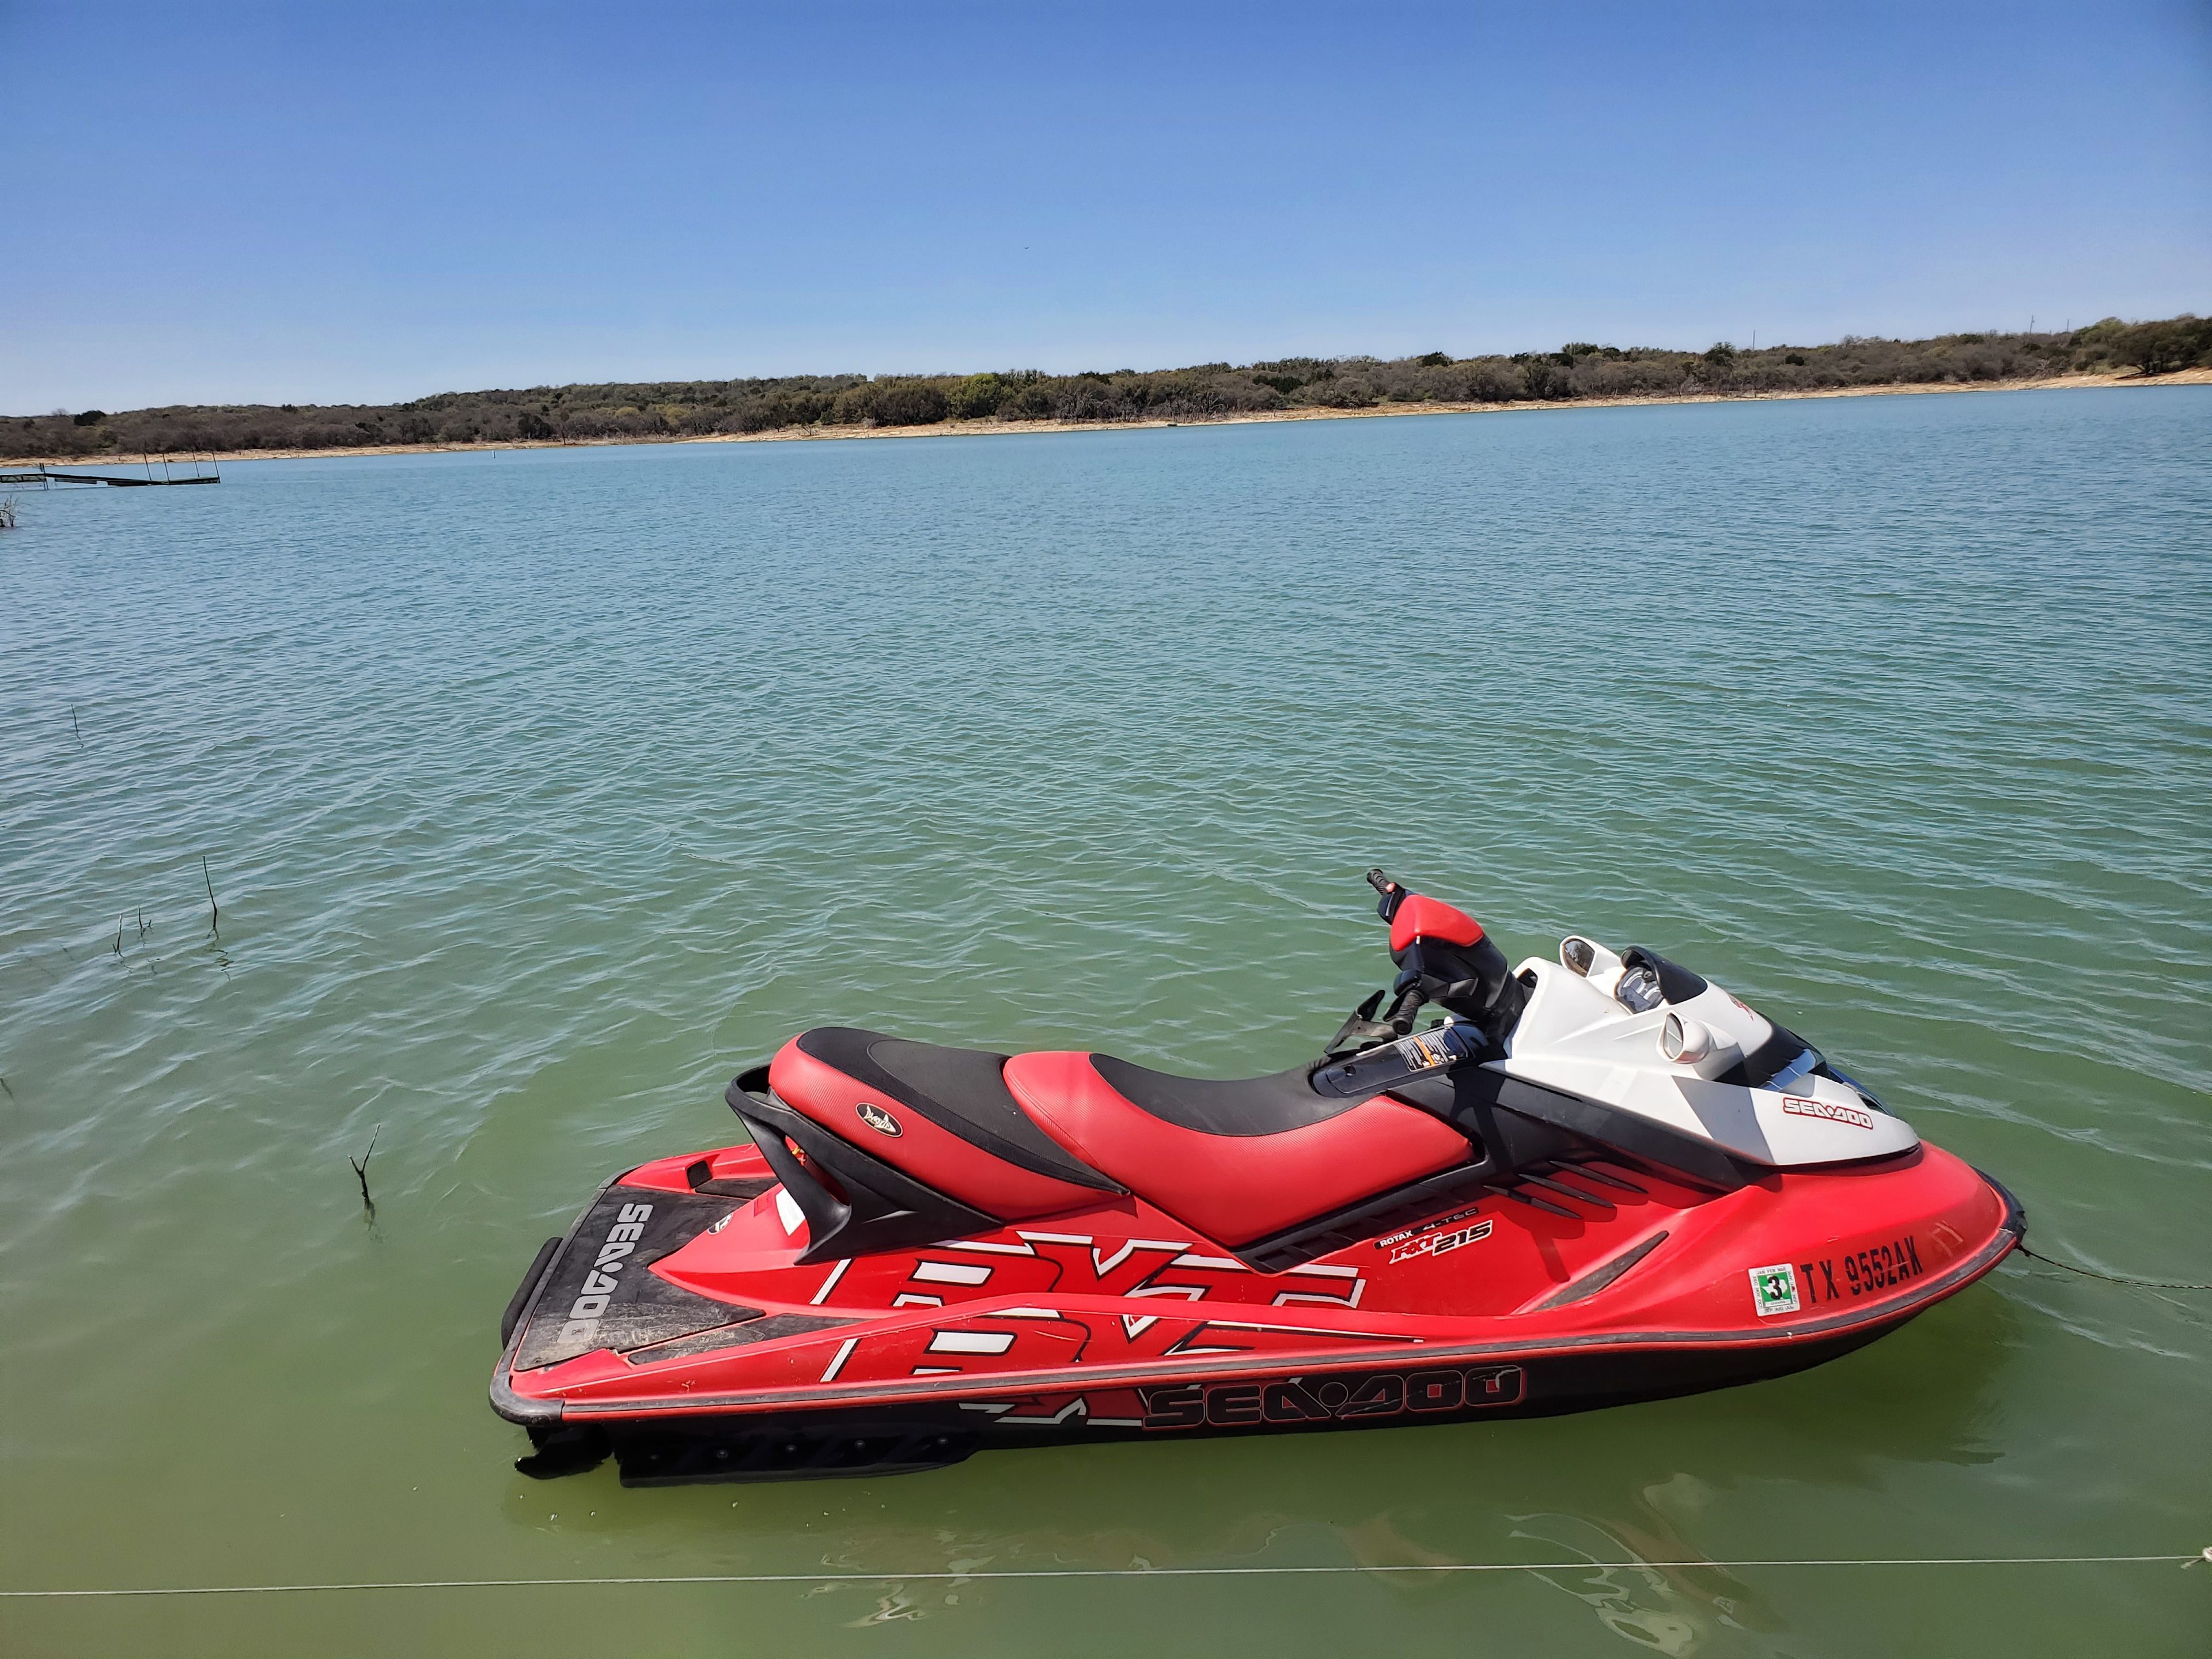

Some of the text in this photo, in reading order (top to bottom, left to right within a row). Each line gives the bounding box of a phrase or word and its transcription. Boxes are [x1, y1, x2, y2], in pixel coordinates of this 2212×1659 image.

[1380, 1230, 1414, 1247] ROTAX
[1800, 1236, 1923, 1303] TX 9552AK
[1768, 1275, 1782, 1300] 3
